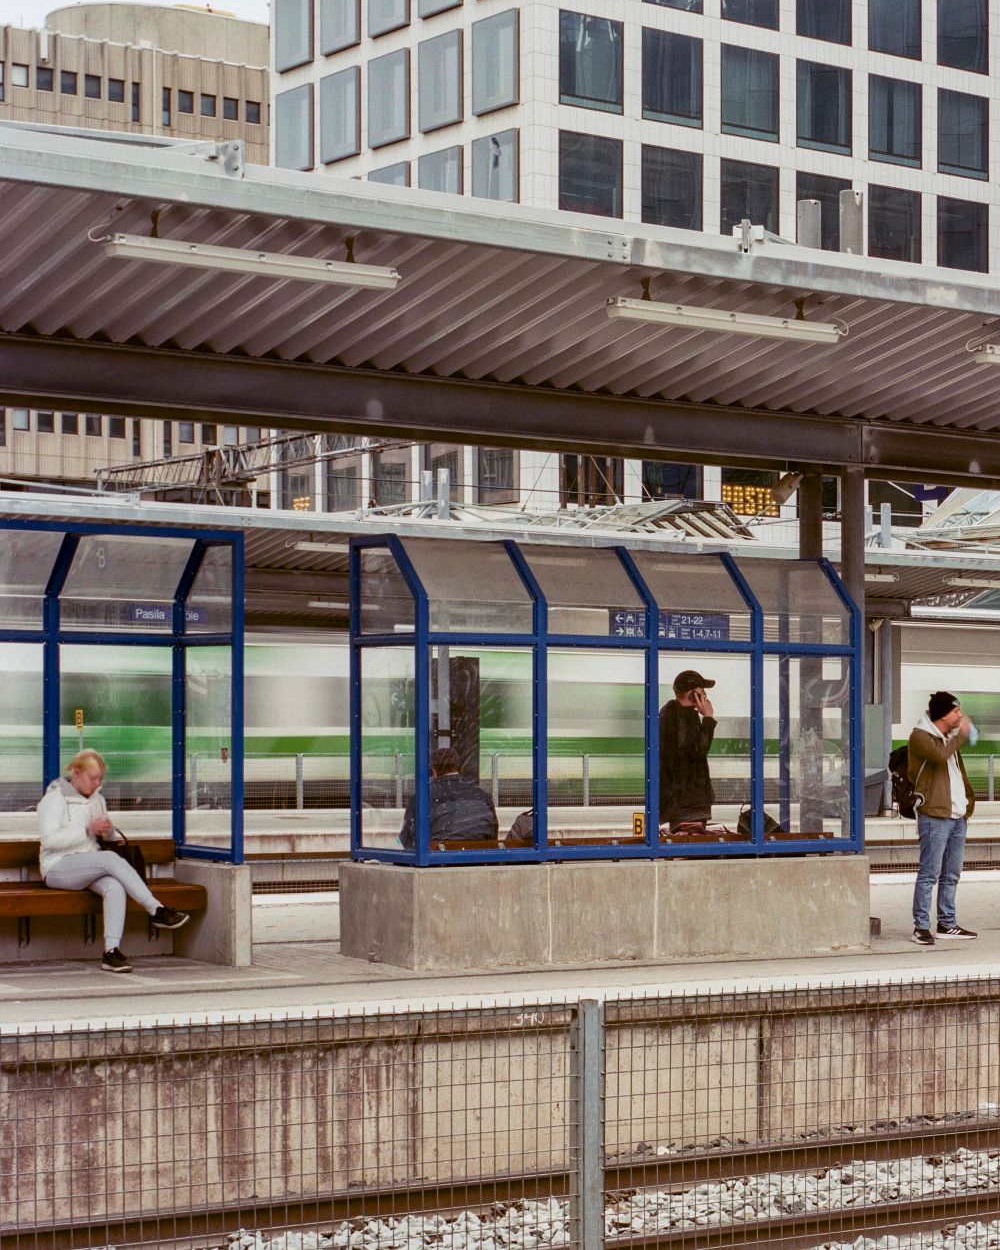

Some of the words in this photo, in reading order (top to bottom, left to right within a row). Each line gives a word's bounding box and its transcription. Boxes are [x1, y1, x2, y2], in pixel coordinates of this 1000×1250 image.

[135, 608, 165, 620] Pasila
[185, 610, 199, 621] öle
[681, 615, 704, 625] 21-22
[691, 629, 721, 640] 1-4,7-11
[634, 818, 643, 835] B
